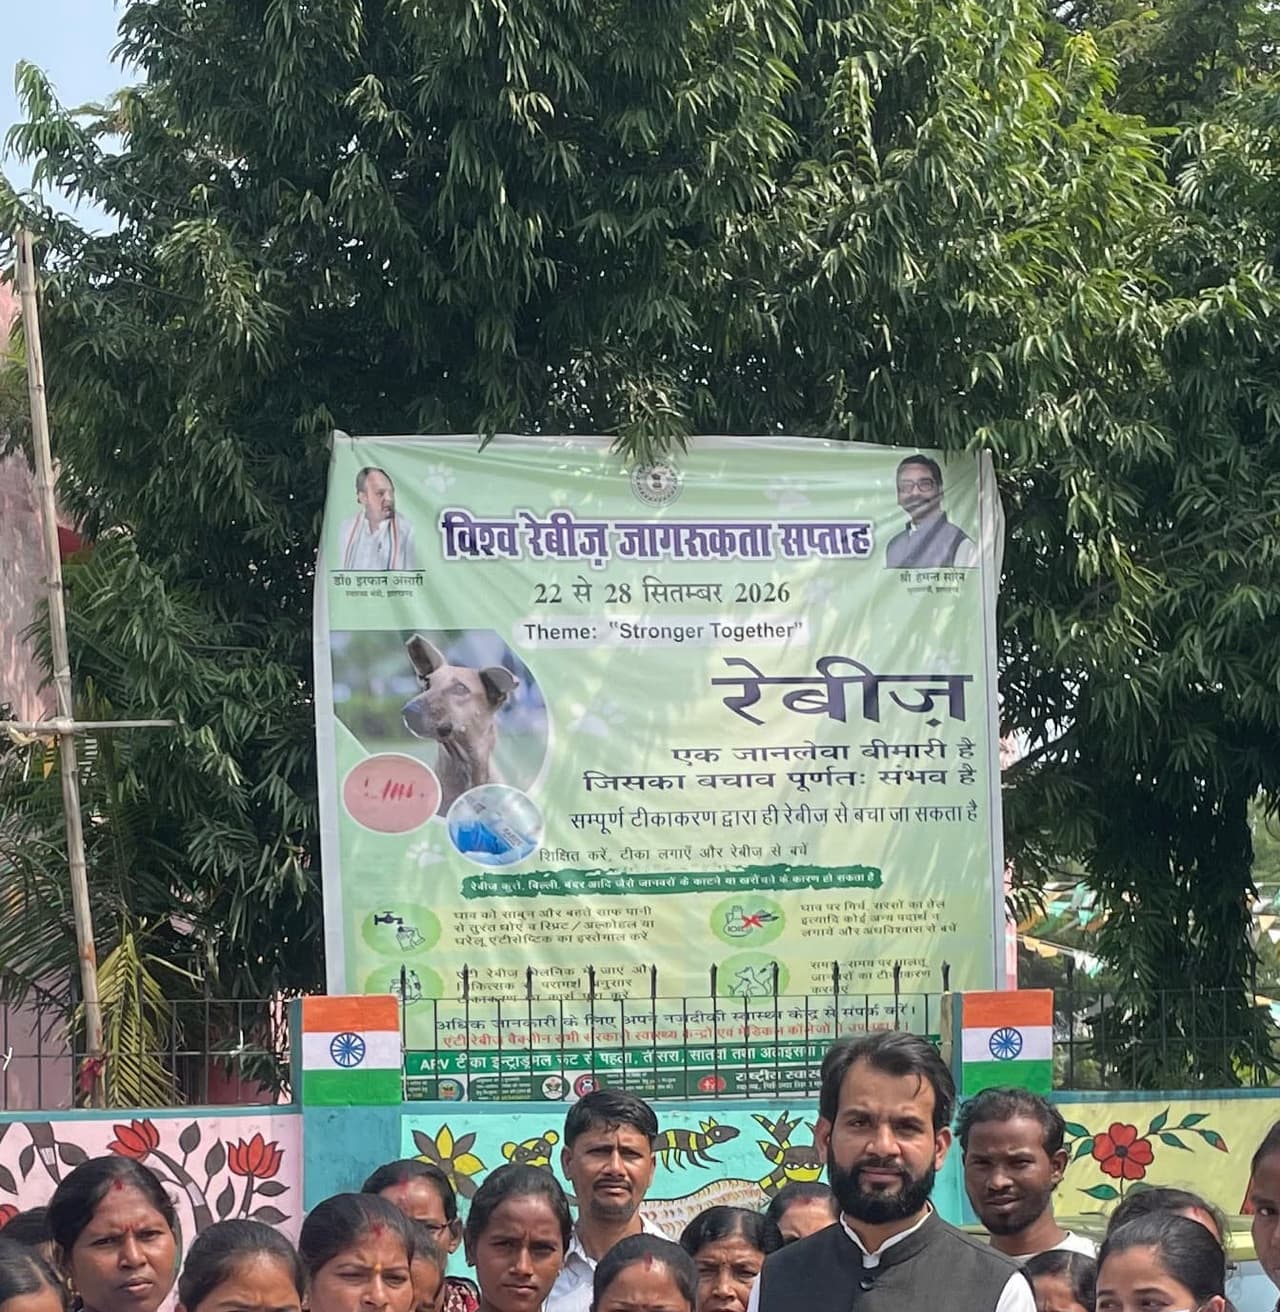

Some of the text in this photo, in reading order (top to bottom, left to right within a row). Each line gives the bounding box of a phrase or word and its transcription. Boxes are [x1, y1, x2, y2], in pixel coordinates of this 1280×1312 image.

[442, 512, 518, 557] विश्व
[520, 511, 608, 567] रेबीज़
[778, 522, 872, 556] सप्ताह
[535, 575, 791, 605] 22 से 28 सितम्बर 2026
[524, 623, 597, 641] Theme:
[711, 655, 974, 728] रेबीज़
[671, 737, 977, 765] एक जानलेवा बीमारी है
[583, 770, 686, 792] जिसका
[696, 772, 776, 789] बचाव
[878, 763, 948, 785] संभव
[957, 764, 977, 785] है
[570, 805, 624, 836] सम्पूर्ण
[630, 805, 715, 829] टीकाकरण
[721, 808, 757, 830] द्वारा
[762, 803, 781, 827] ही
[834, 800, 850, 825] से
[852, 807, 885, 824] बचा
[888, 806, 910, 823] जा
[914, 805, 963, 823] सकता
[965, 800, 979, 822] है
[539, 847, 580, 863] शिक्षित
[620, 847, 650, 861] टीका
[699, 844, 723, 859] और
[770, 843, 781, 858] से
[436, 1016, 486, 1031] अधिक
[562, 1013, 579, 1028] के
